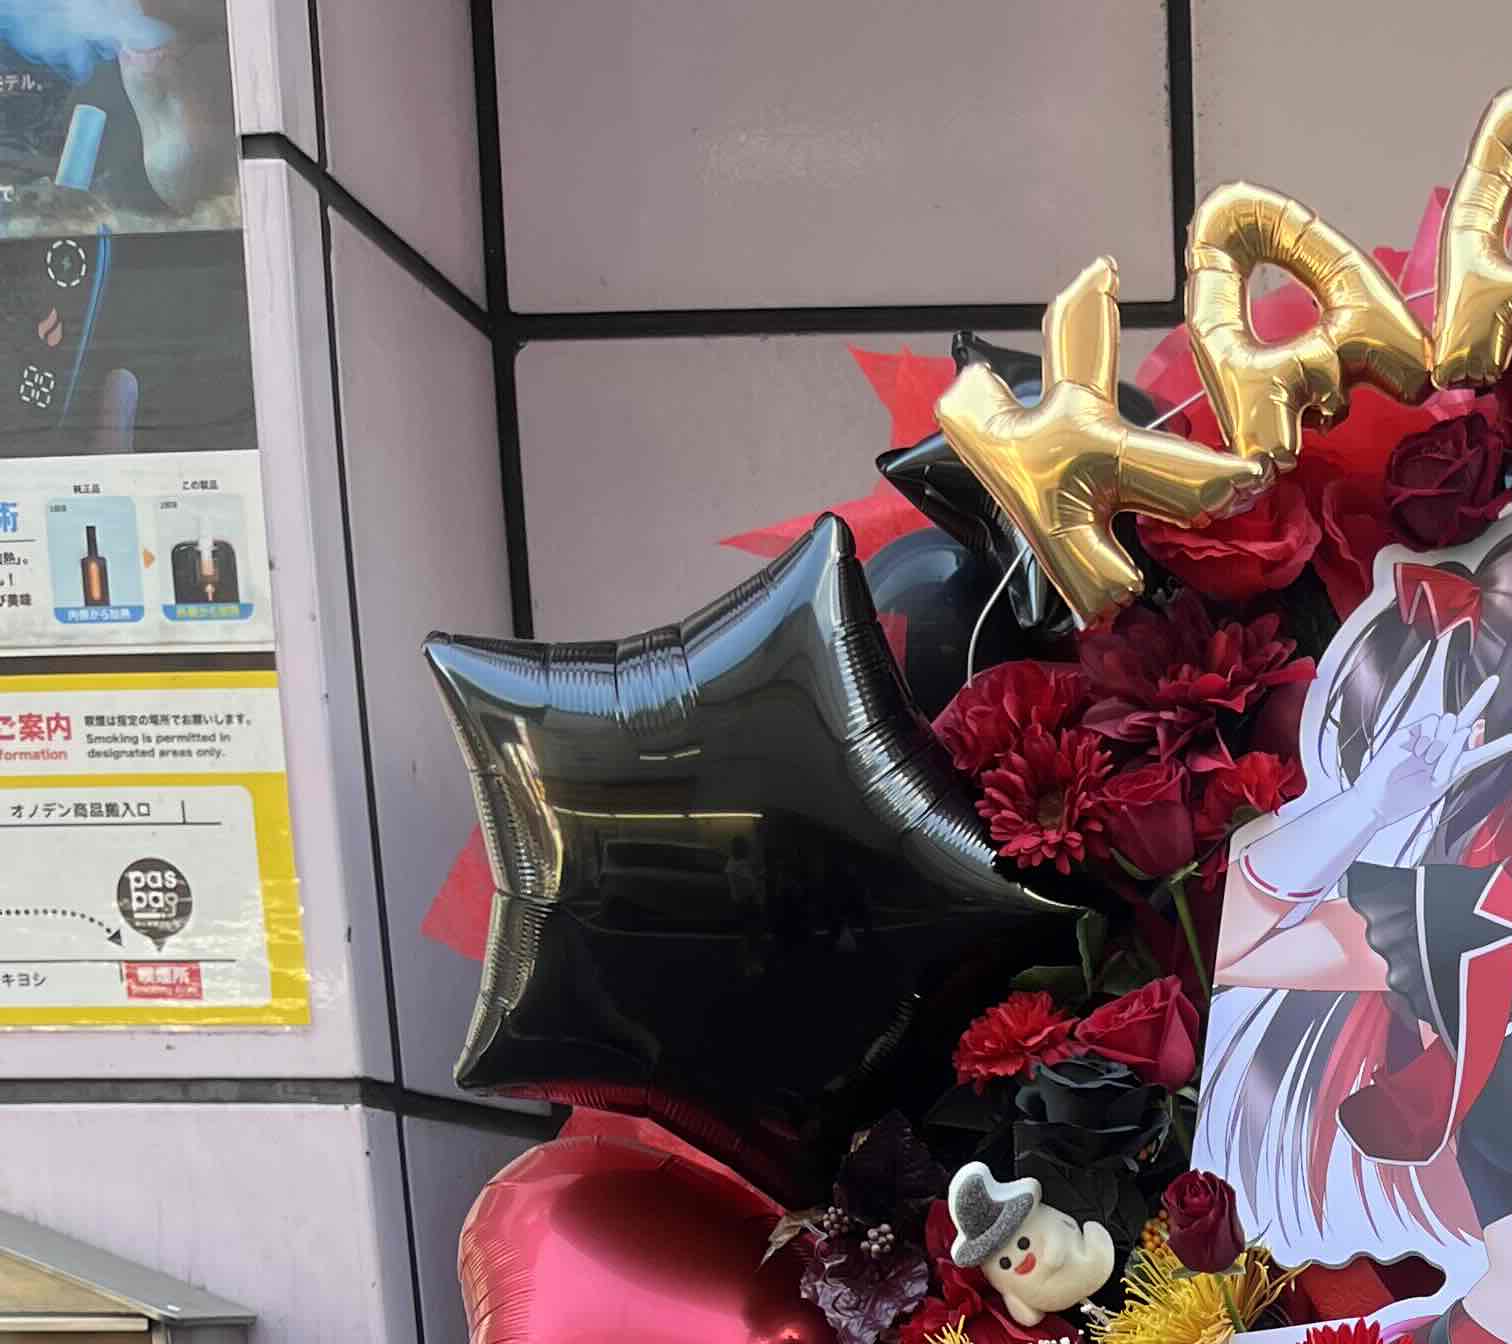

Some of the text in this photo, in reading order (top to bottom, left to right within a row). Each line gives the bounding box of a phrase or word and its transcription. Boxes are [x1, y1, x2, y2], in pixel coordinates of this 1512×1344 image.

[86, 732, 231, 745] Smoking is permitted in
[87, 747, 155, 760] designated
[159, 749, 193, 759] areas
[10, 802, 151, 819] オノデン商品搬入口
